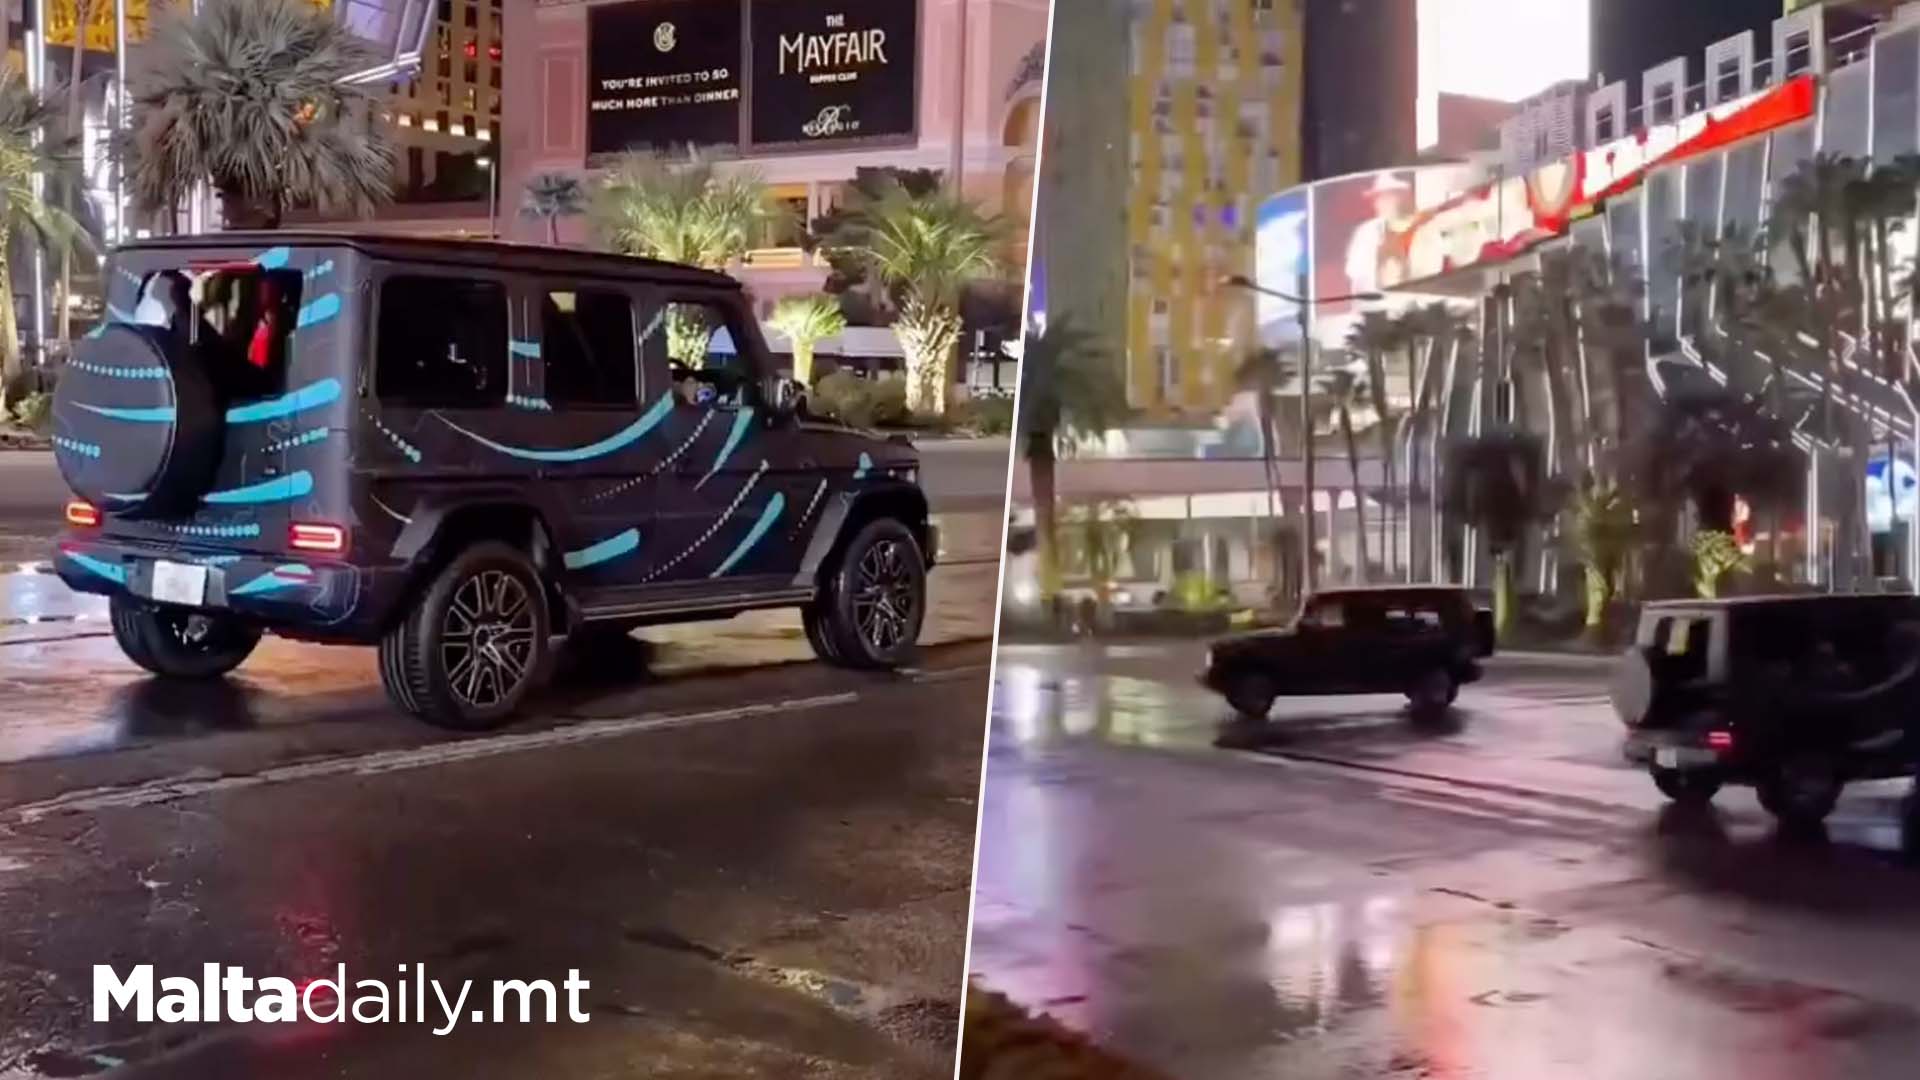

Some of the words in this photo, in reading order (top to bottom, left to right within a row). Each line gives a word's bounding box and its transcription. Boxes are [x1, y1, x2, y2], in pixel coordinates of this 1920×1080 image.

[779, 29, 888, 74] MAYFAIR
[601, 77, 643, 89] YOU'RE
[645, 74, 691, 87] INVITED
[694, 70, 710, 82] TO
[592, 99, 623, 110] MUCH
[626, 97, 658, 108] MORE
[661, 95, 691, 106] THAN
[694, 88, 739, 103] DINNER
